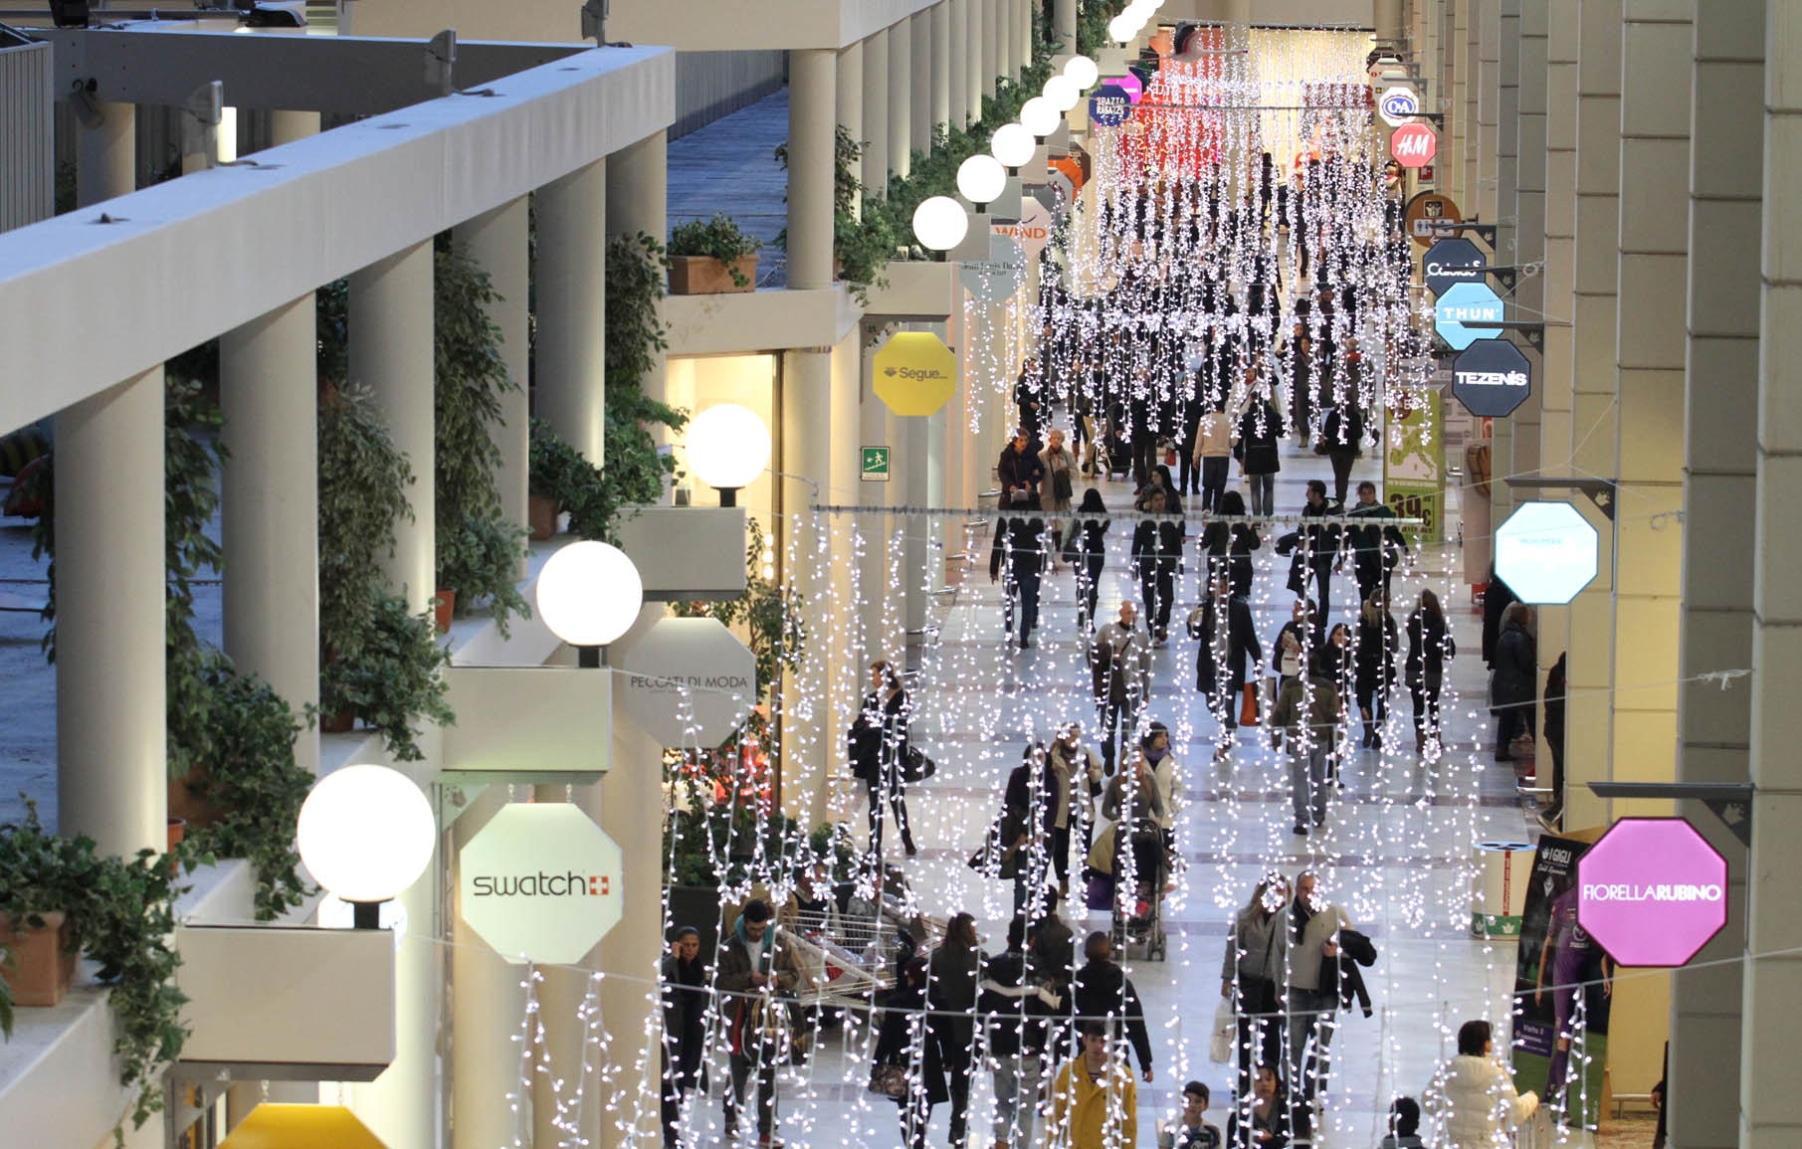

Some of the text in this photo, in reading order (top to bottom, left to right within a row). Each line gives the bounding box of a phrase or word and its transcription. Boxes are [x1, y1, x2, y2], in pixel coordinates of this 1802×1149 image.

[1397, 134, 1430, 156] H&M
[1444, 307, 1495, 320] THUN
[630, 676, 748, 689] PECCATI DI MODA
[473, 870, 587, 896] swatch
